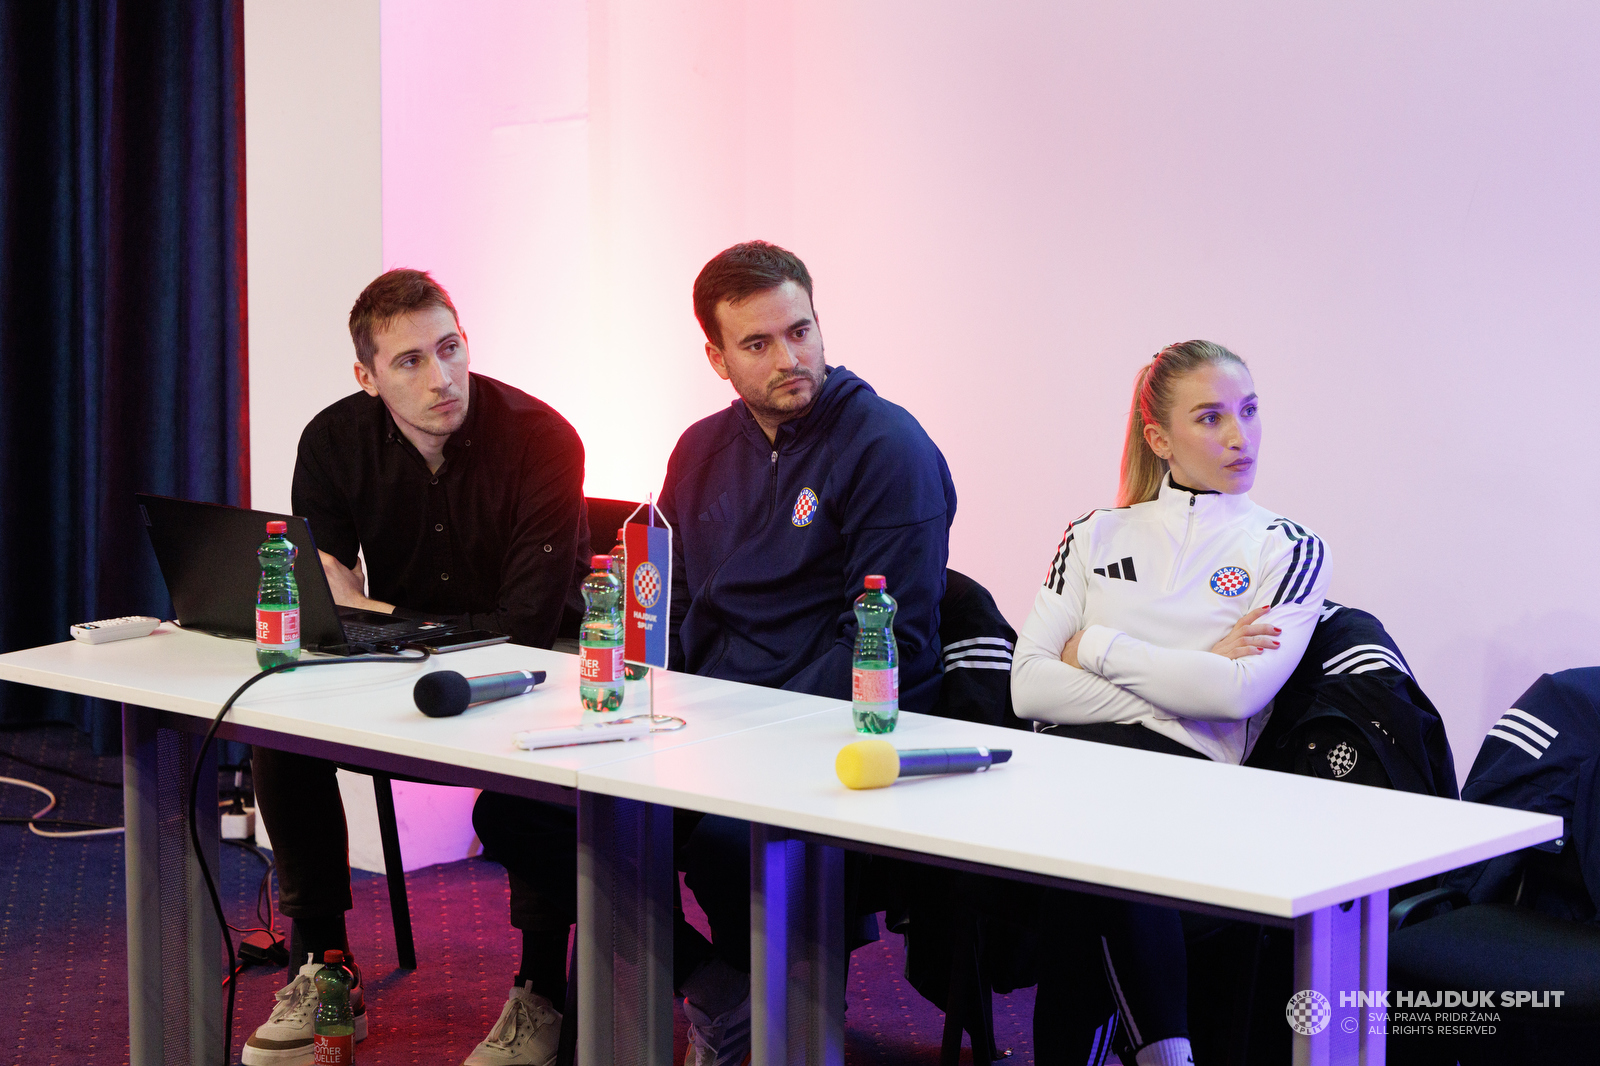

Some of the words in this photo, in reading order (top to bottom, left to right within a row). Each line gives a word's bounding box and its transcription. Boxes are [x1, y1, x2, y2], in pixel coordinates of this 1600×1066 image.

[1216, 567, 1249, 579] HAJDUK
[1213, 586, 1238, 596] SPLIT
[633, 611, 658, 623] HAJDUK
[637, 621, 654, 631] SPLIT
[314, 1045, 341, 1055] OMER
